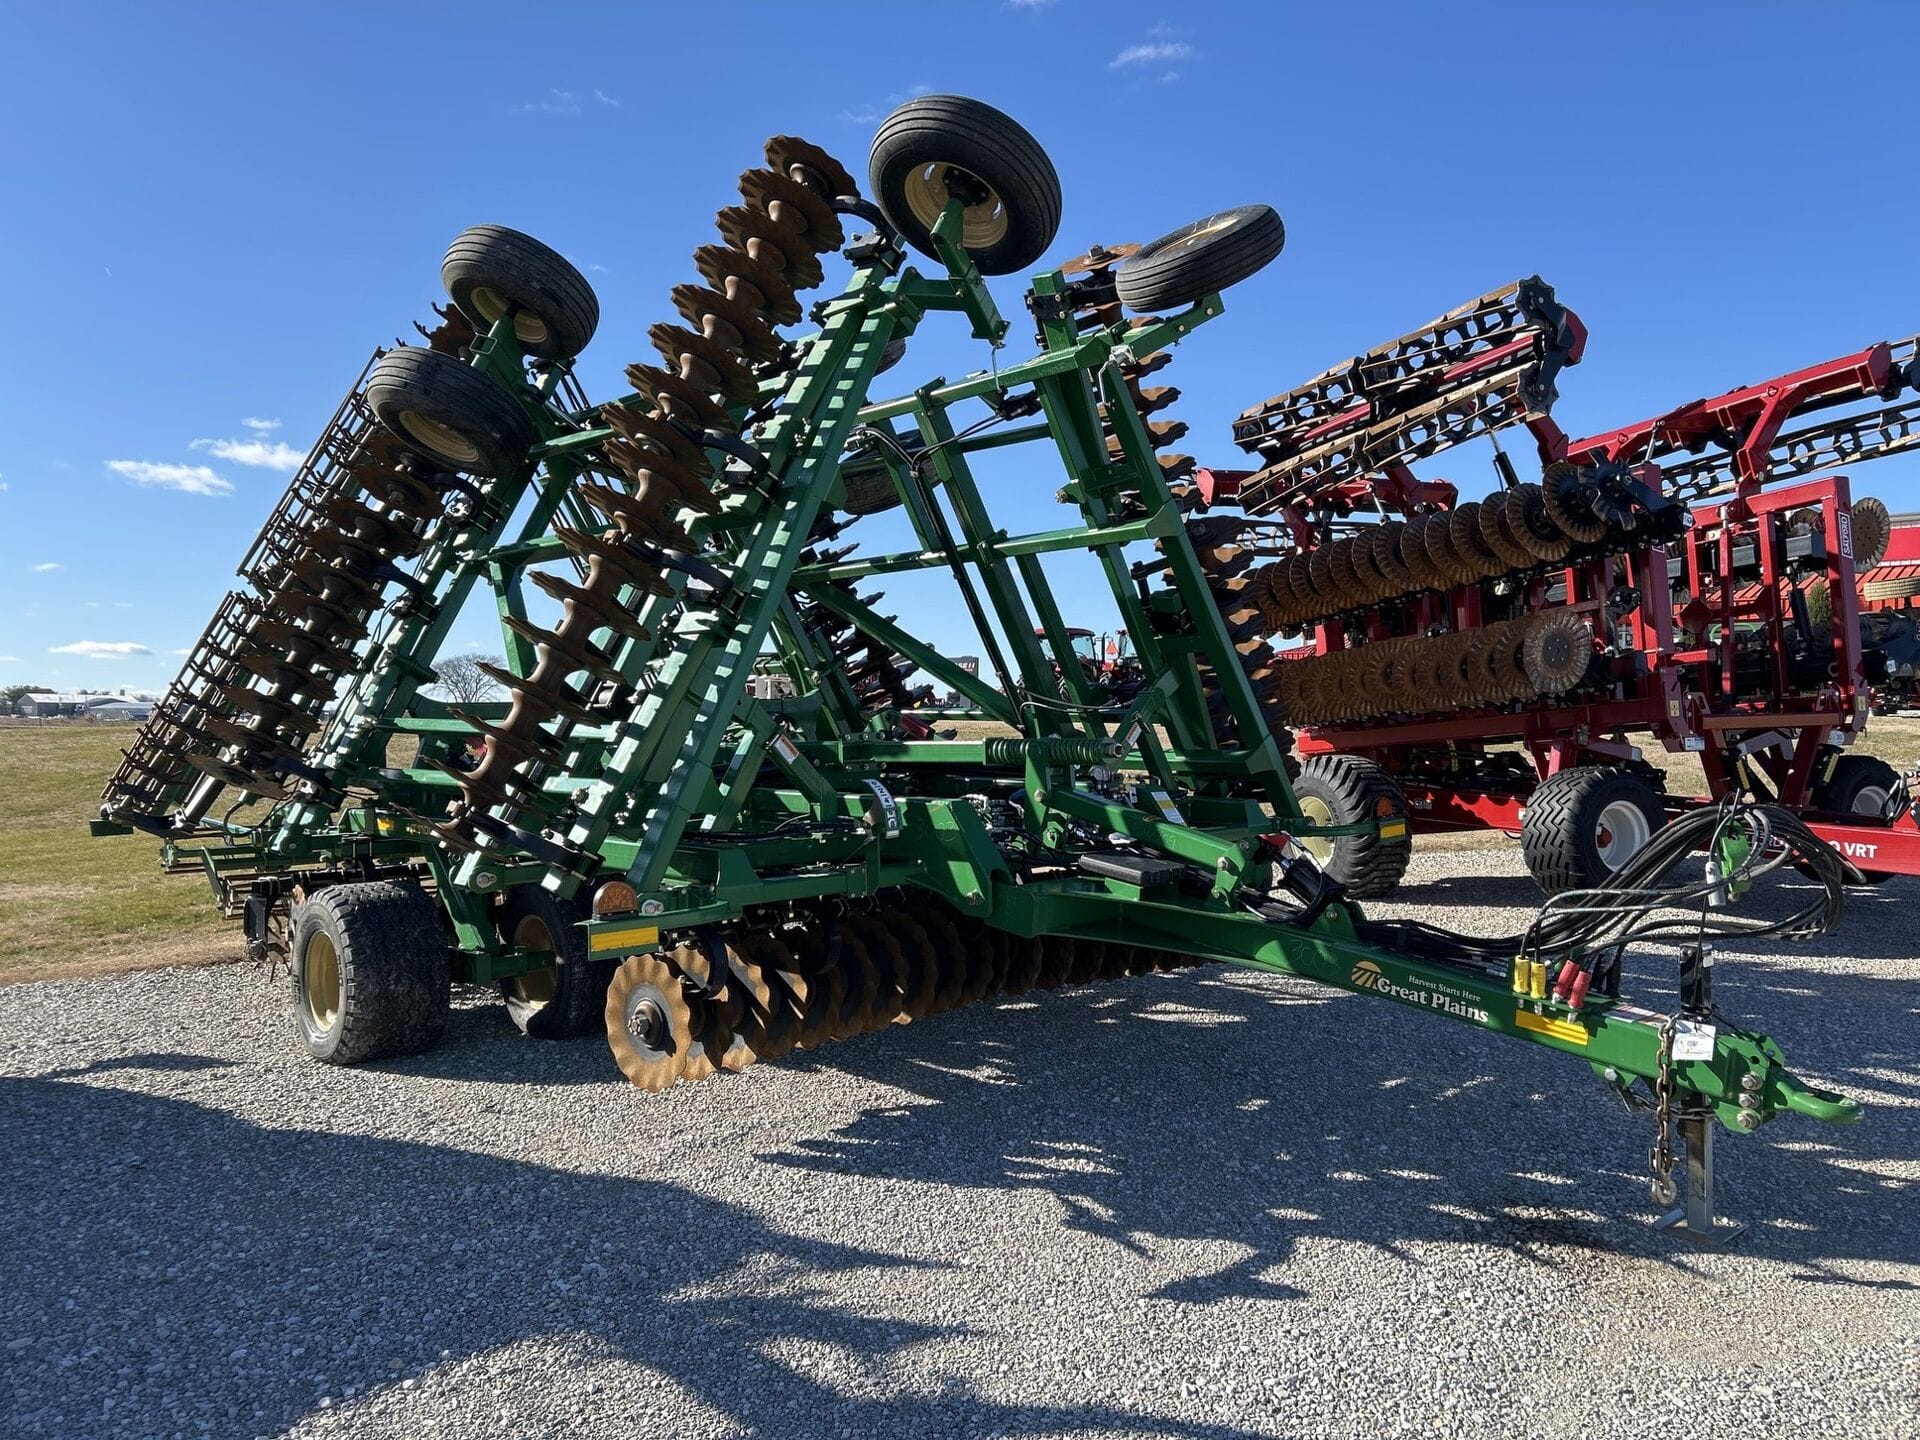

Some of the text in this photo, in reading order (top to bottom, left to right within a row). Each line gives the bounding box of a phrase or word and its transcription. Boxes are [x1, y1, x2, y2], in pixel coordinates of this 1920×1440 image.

[1840, 516, 1851, 555] SALFORD
[1843, 841, 1878, 859] VRT
[1376, 977, 1489, 1023] Great Plains
[1408, 975, 1481, 1003] Harvest Starts Here
